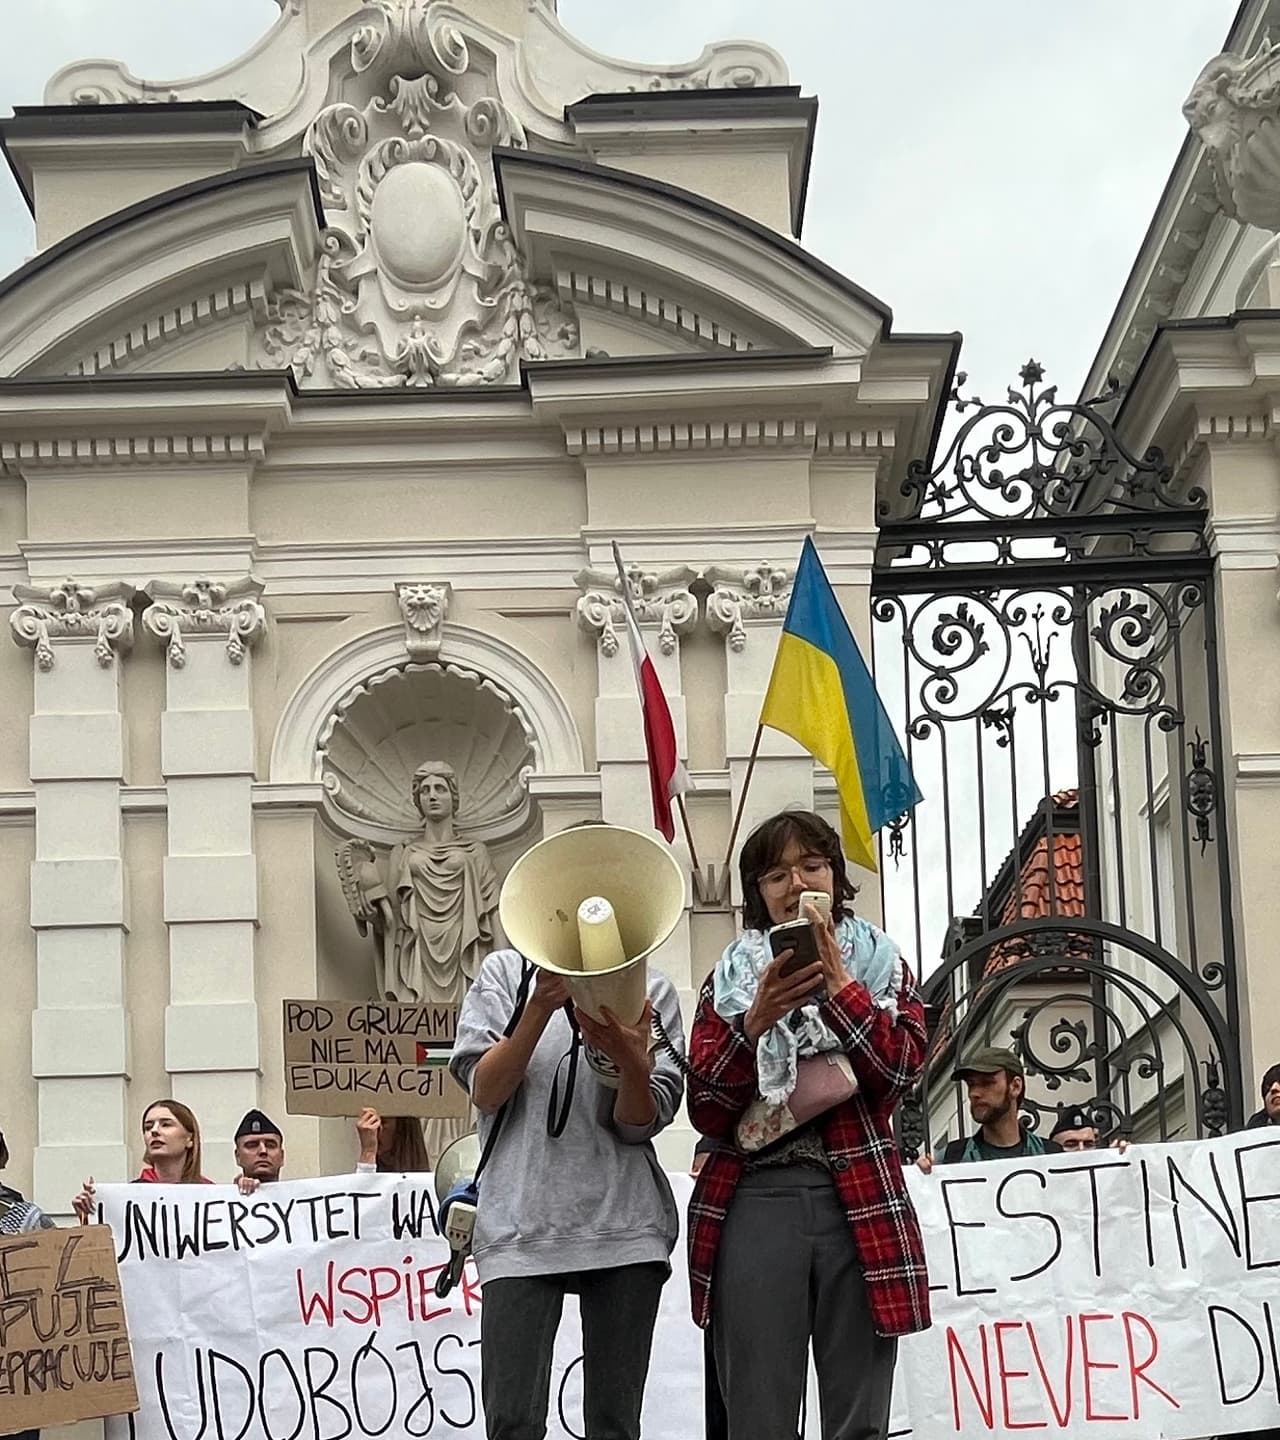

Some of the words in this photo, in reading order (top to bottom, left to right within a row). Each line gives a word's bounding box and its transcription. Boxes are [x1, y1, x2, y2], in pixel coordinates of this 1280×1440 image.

[287, 1003, 334, 1033] POD
[346, 1004, 458, 1038] GRUZAMI
[311, 1035, 356, 1065] NIE
[364, 1038, 402, 1066] MA
[290, 1064, 444, 1097] EDUKACJI
[296, 1255, 484, 1328] WSPIER
[945, 1310, 1182, 1432] NEVER
